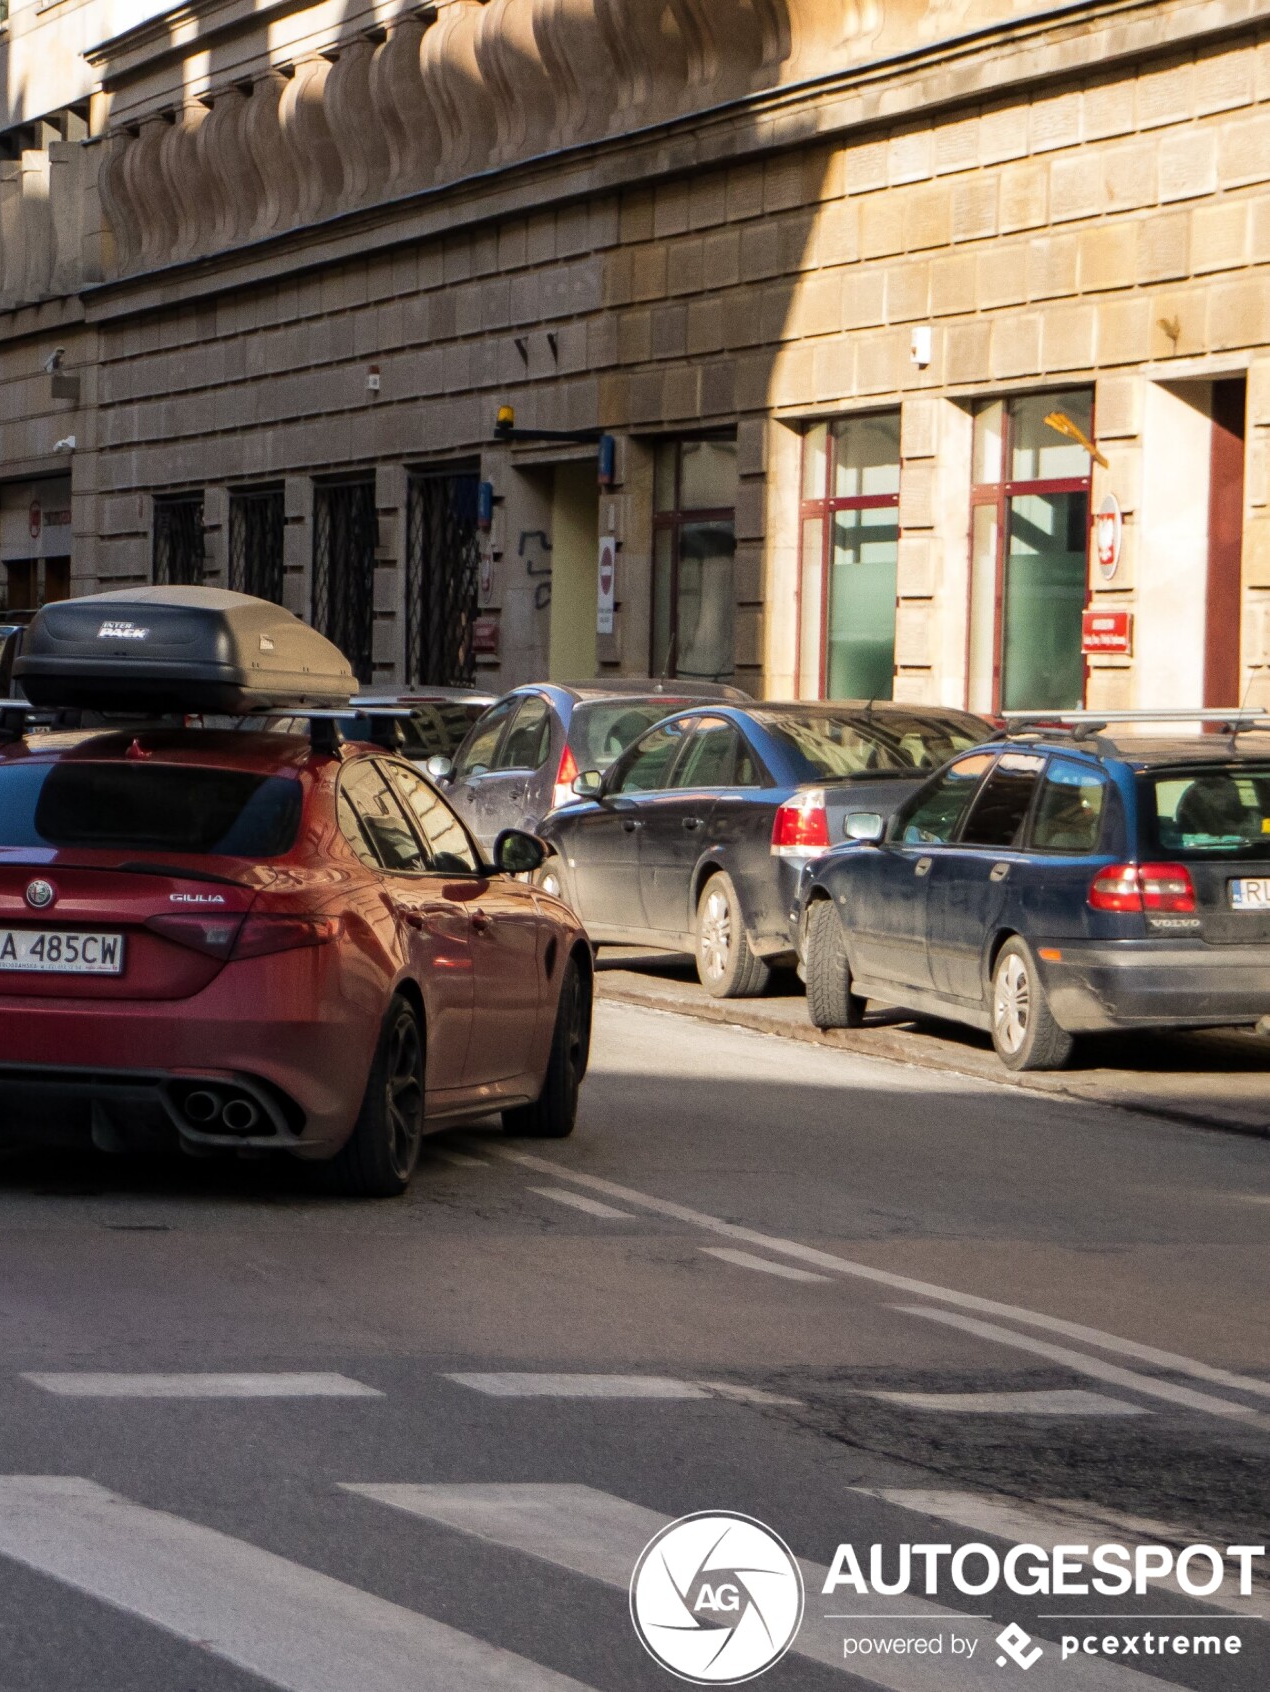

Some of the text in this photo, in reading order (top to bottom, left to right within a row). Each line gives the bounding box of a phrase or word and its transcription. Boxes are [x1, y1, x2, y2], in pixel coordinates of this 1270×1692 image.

[98, 628, 148, 638] PACK
[169, 893, 226, 903] GIULIA
[1150, 919, 1201, 928] VOLVO
[29, 934, 118, 965] 485CW
